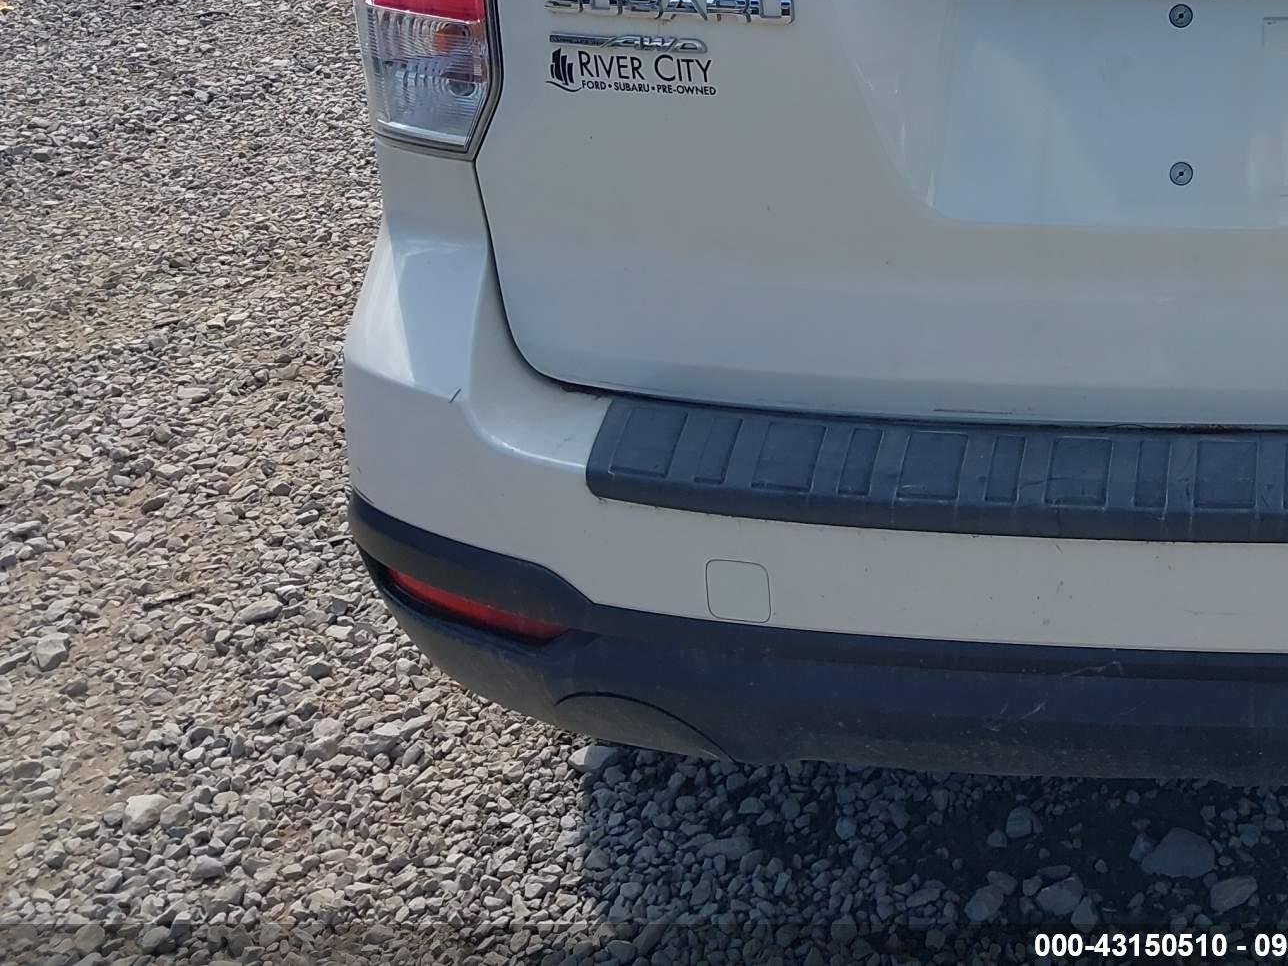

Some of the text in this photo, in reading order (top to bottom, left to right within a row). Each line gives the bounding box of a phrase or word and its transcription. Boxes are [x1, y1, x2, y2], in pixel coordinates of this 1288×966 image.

[577, 50, 712, 83] RIVER CITY
[582, 80, 717, 97] FORD SUBARU PRE-OWNED
